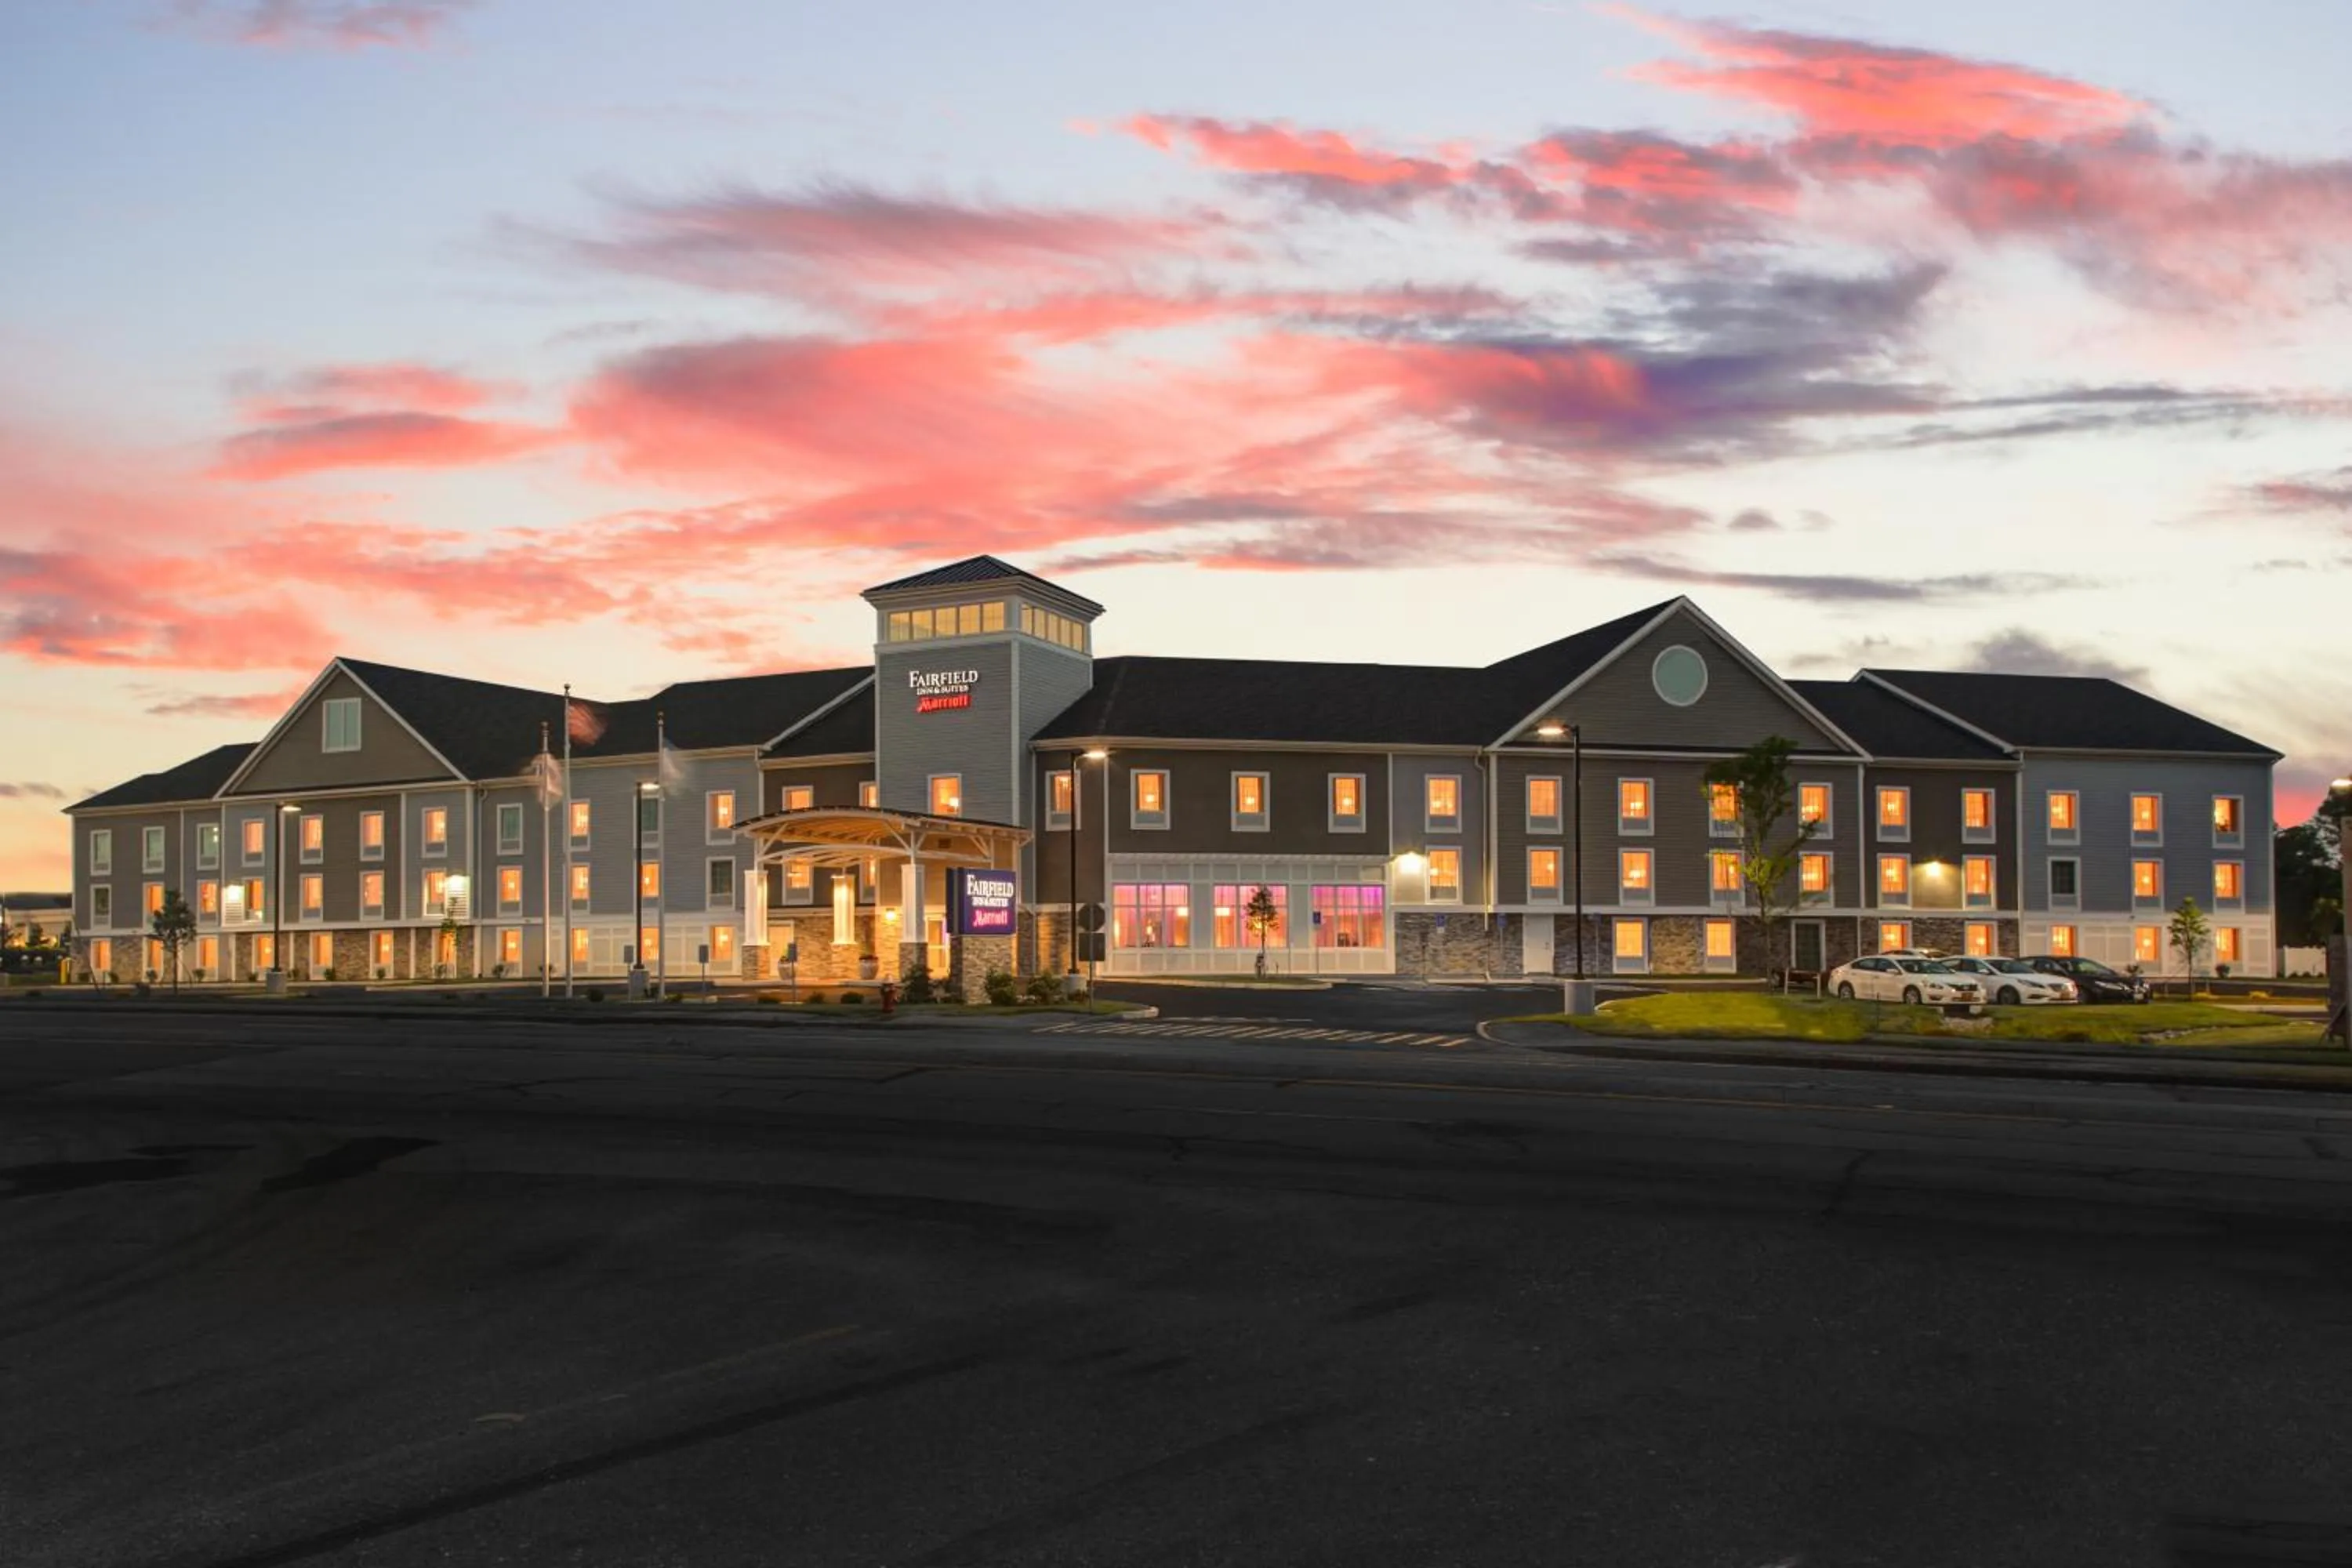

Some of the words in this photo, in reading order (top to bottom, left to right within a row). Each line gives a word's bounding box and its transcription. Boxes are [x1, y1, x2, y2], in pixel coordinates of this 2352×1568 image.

[909, 670, 978, 688] FAIRFIELD
[916, 695, 968, 713] Marriott
[967, 874, 1014, 898] FAIRFIELD
[972, 909, 1008, 927] Marriott
